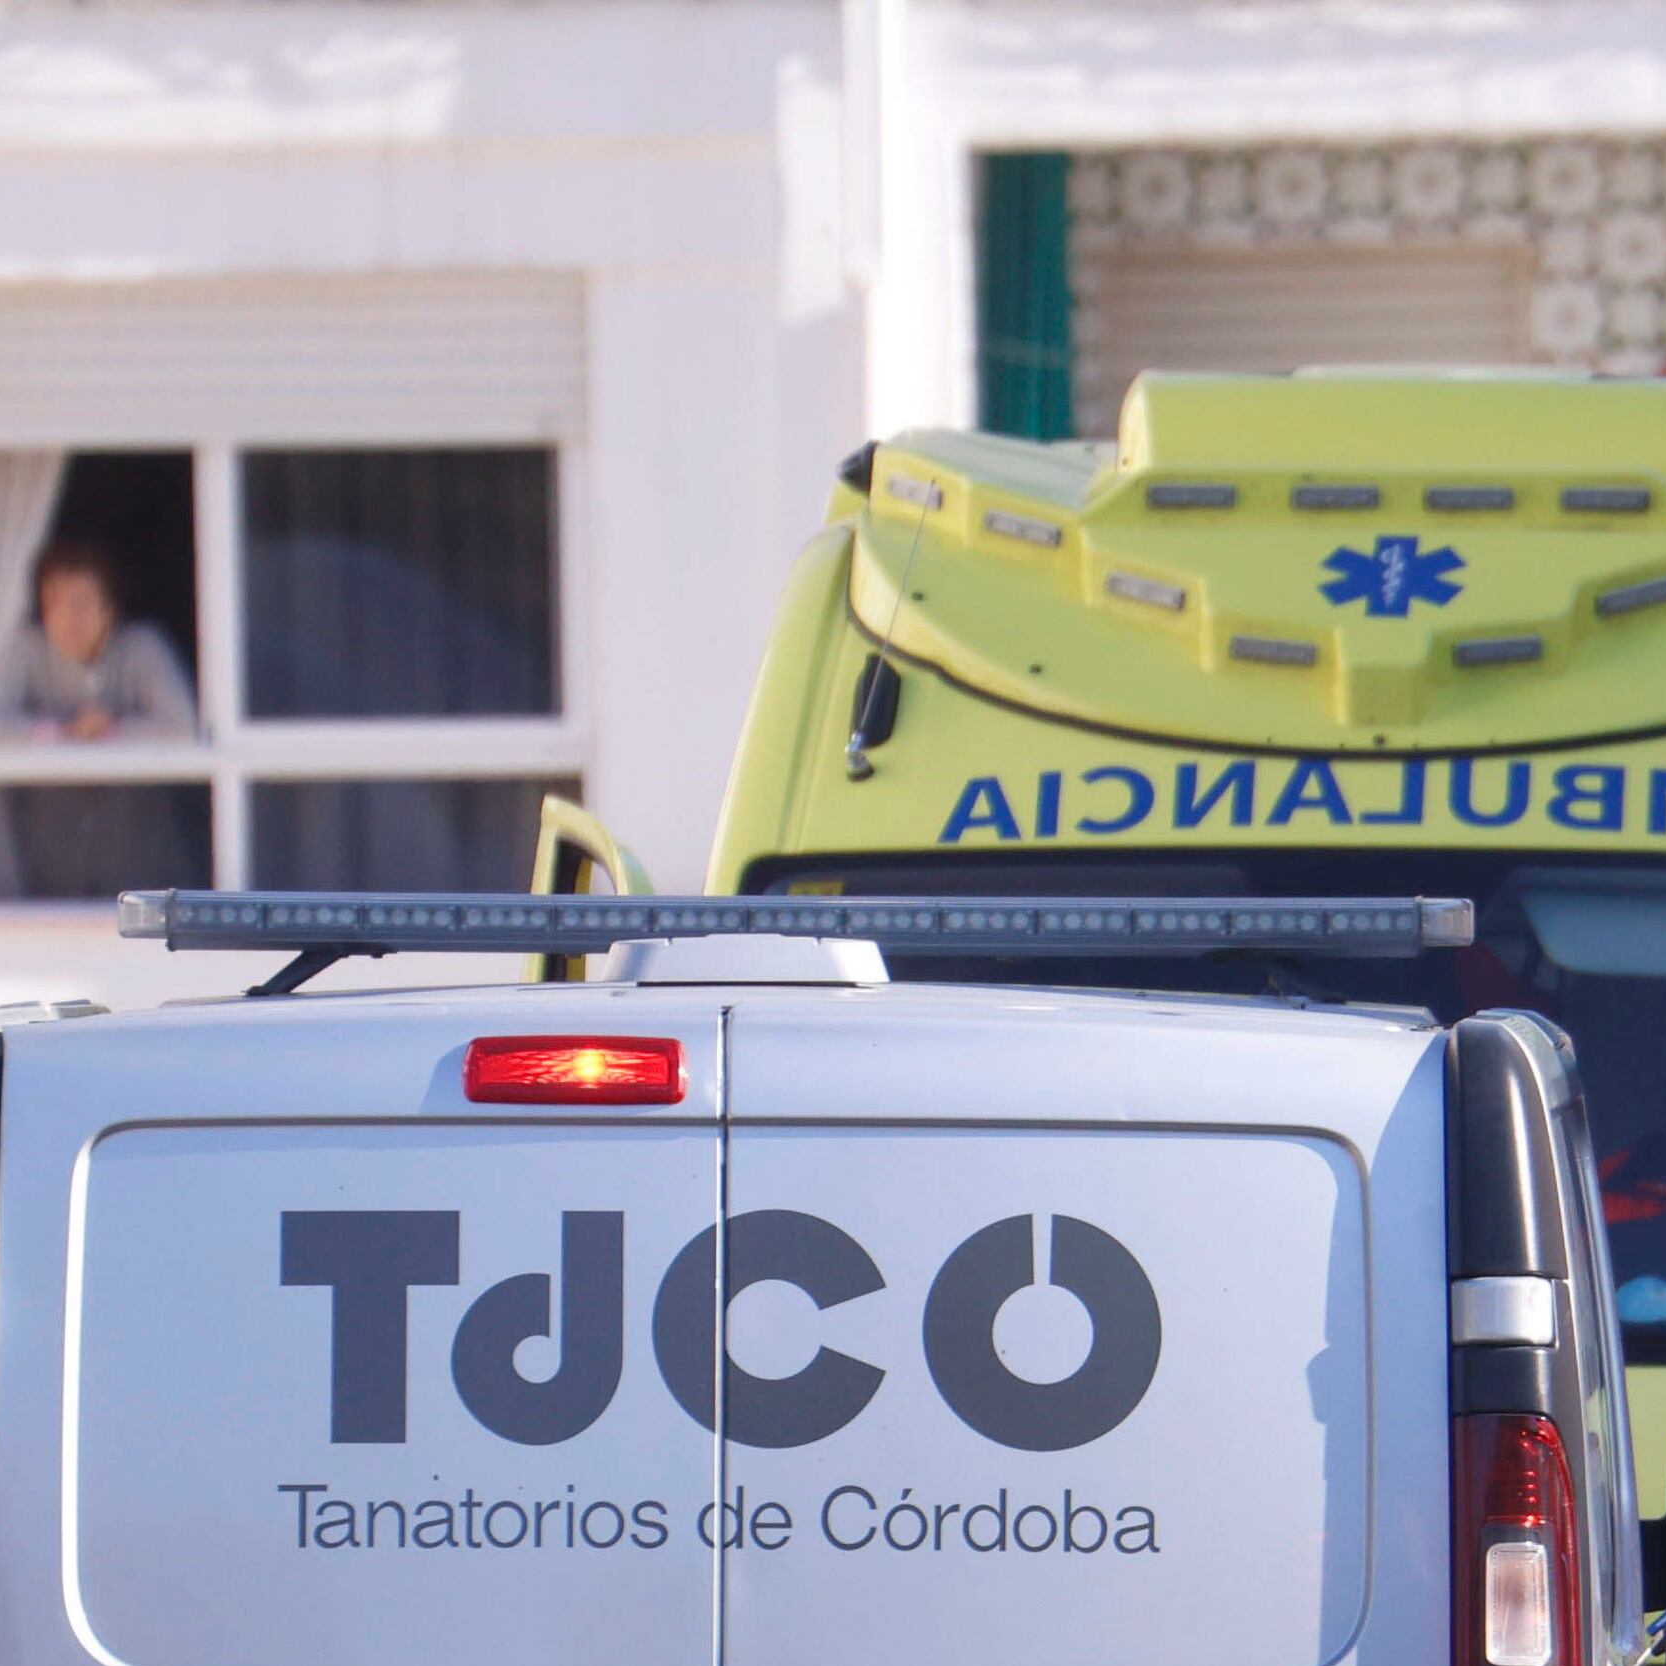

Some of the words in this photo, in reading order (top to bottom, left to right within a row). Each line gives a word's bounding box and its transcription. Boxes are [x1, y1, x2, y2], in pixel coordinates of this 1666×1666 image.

[278, 1484, 669, 1549] Tanatorios
[698, 1486, 792, 1550] de
[821, 1484, 1161, 1553] Córdoba
